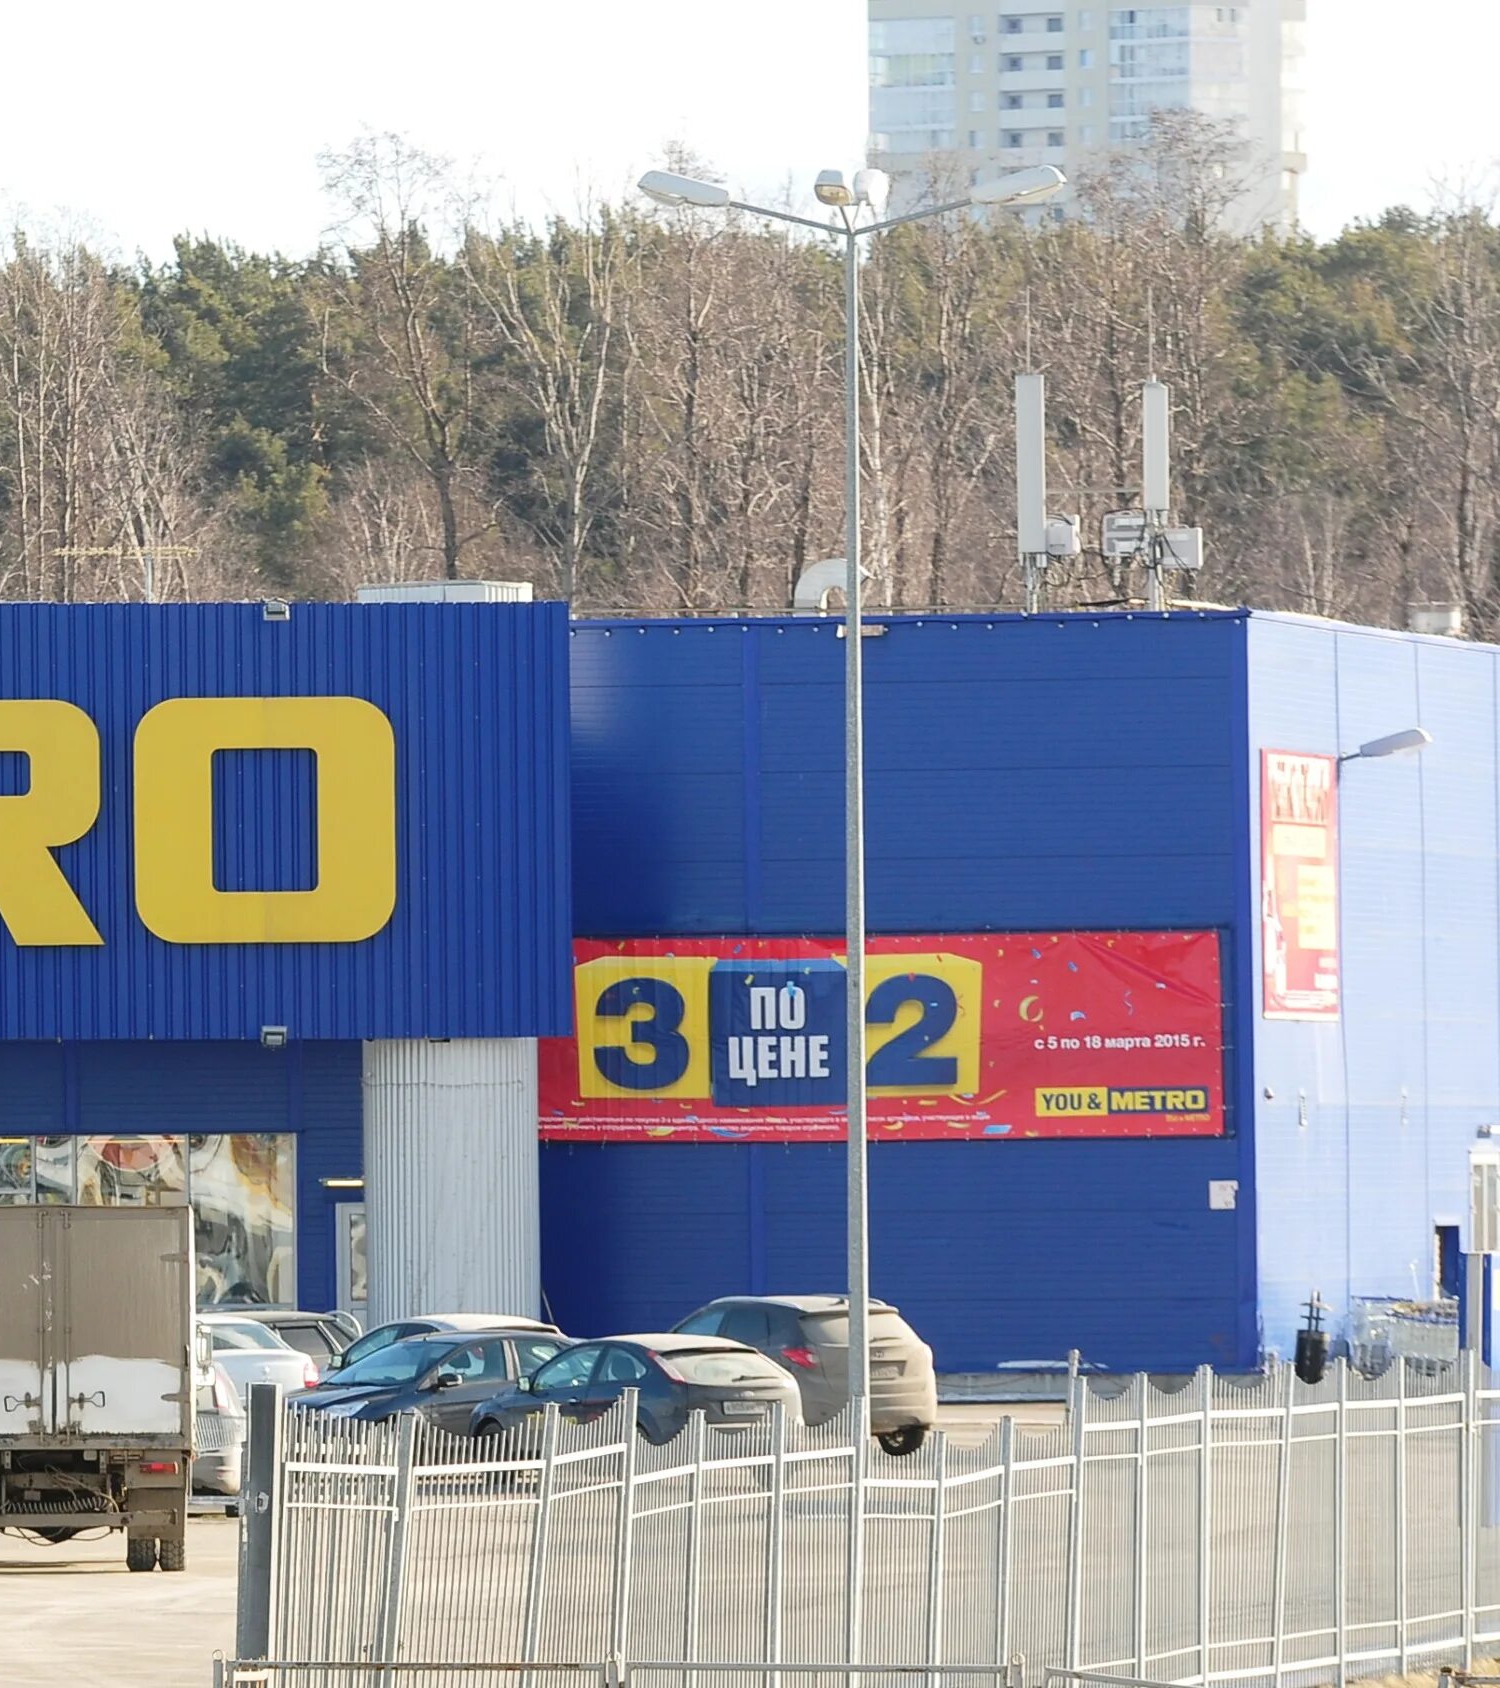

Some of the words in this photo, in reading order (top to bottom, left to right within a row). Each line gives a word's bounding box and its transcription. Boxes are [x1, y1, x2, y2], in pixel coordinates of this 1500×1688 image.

[749, 986, 806, 1031] ПО
[864, 973, 958, 1087] 2
[593, 976, 690, 1091] 3
[1047, 1036, 1059, 1050] 5
[1060, 1038, 1081, 1050] по
[1084, 1036, 1102, 1049] 18
[1104, 1037, 1151, 1051] марта
[1154, 1034, 1190, 1048] 2015
[728, 1035, 831, 1087] ЦЕНЕ
[1041, 1093, 1082, 1111] YOU
[1087, 1092, 1102, 1110] &
[1110, 1089, 1206, 1111] METRO
